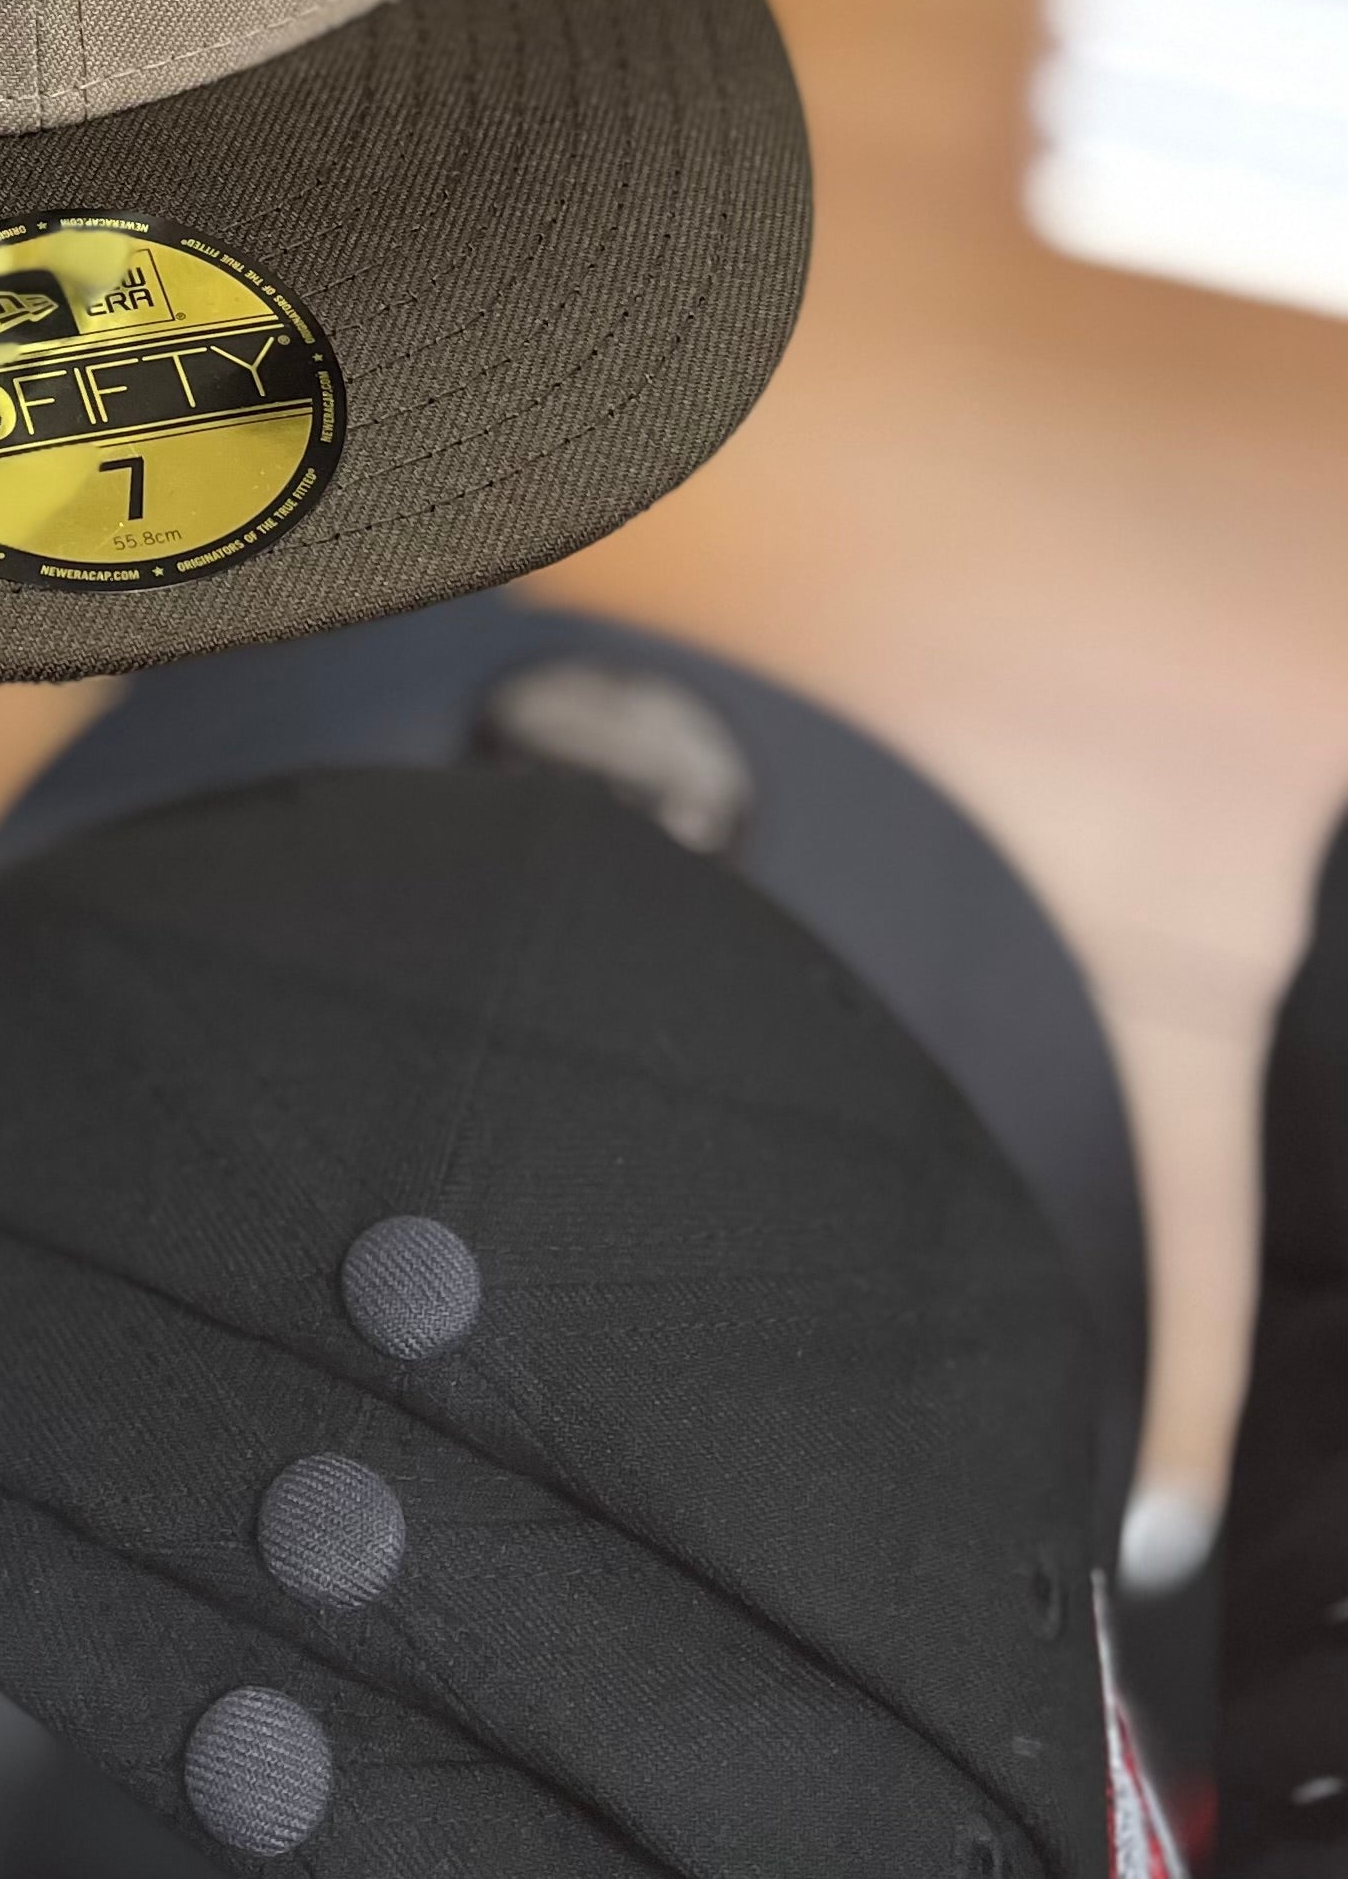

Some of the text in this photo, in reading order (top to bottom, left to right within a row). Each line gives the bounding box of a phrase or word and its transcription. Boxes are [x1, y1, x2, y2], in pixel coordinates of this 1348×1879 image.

[219, 254, 246, 274] TRUE
[244, 269, 264, 288] THE
[260, 284, 277, 297] OF
[99, 456, 145, 521] 7
[113, 528, 182, 551] 55.8cm
[176, 538, 245, 573] ORIGINATORS
[243, 530, 258, 544] OF
[256, 515, 279, 536] THE
[273, 498, 299, 521] TRUE
[40, 564, 140, 581] NEWERACAP.COM
